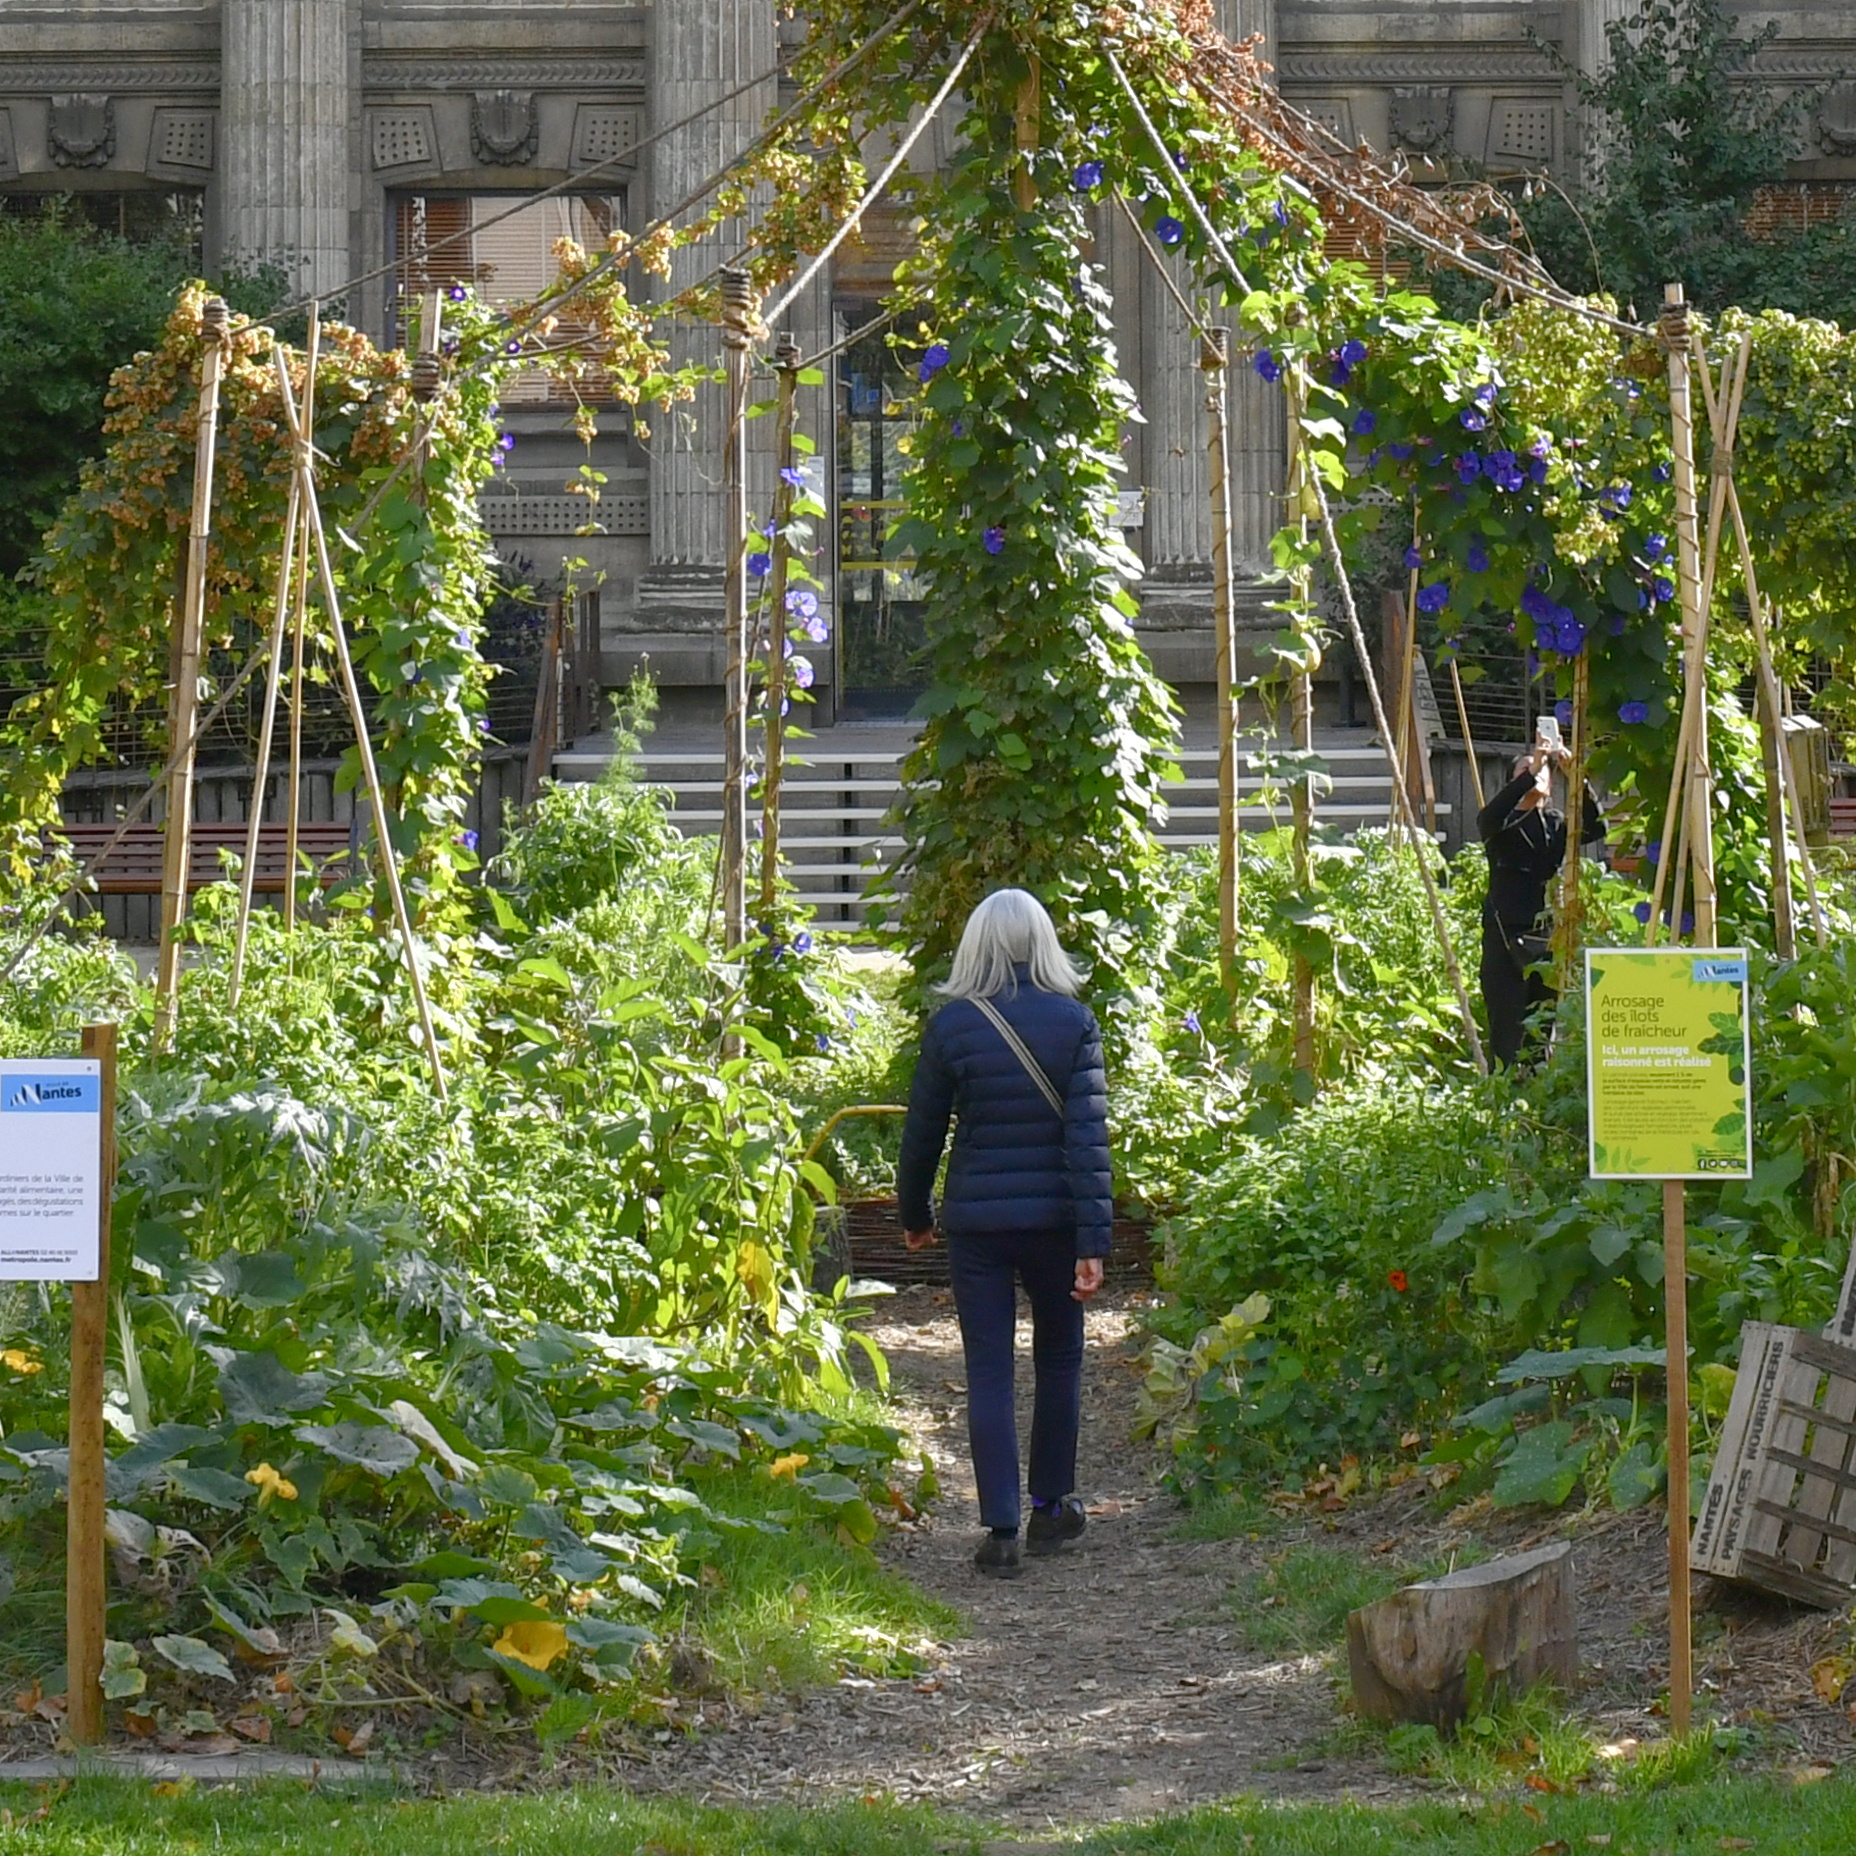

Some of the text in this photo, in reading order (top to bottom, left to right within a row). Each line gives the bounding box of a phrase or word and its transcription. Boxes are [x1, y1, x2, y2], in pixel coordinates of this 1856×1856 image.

[1601, 995, 1664, 1009] Arrosage
[1601, 1010, 1626, 1022] des
[1602, 1025, 1619, 1037] de
[1621, 1046, 1636, 1055] un
[1639, 1046, 1689, 1056] arrosage
[1602, 1057, 1652, 1067] raisonné
[1655, 1057, 1671, 1067] est
[32, 1175, 42, 1183] de
[72, 1175, 83, 1183] de
[1721, 1340, 1784, 1561] PAYSAGES NOURRICIERS
